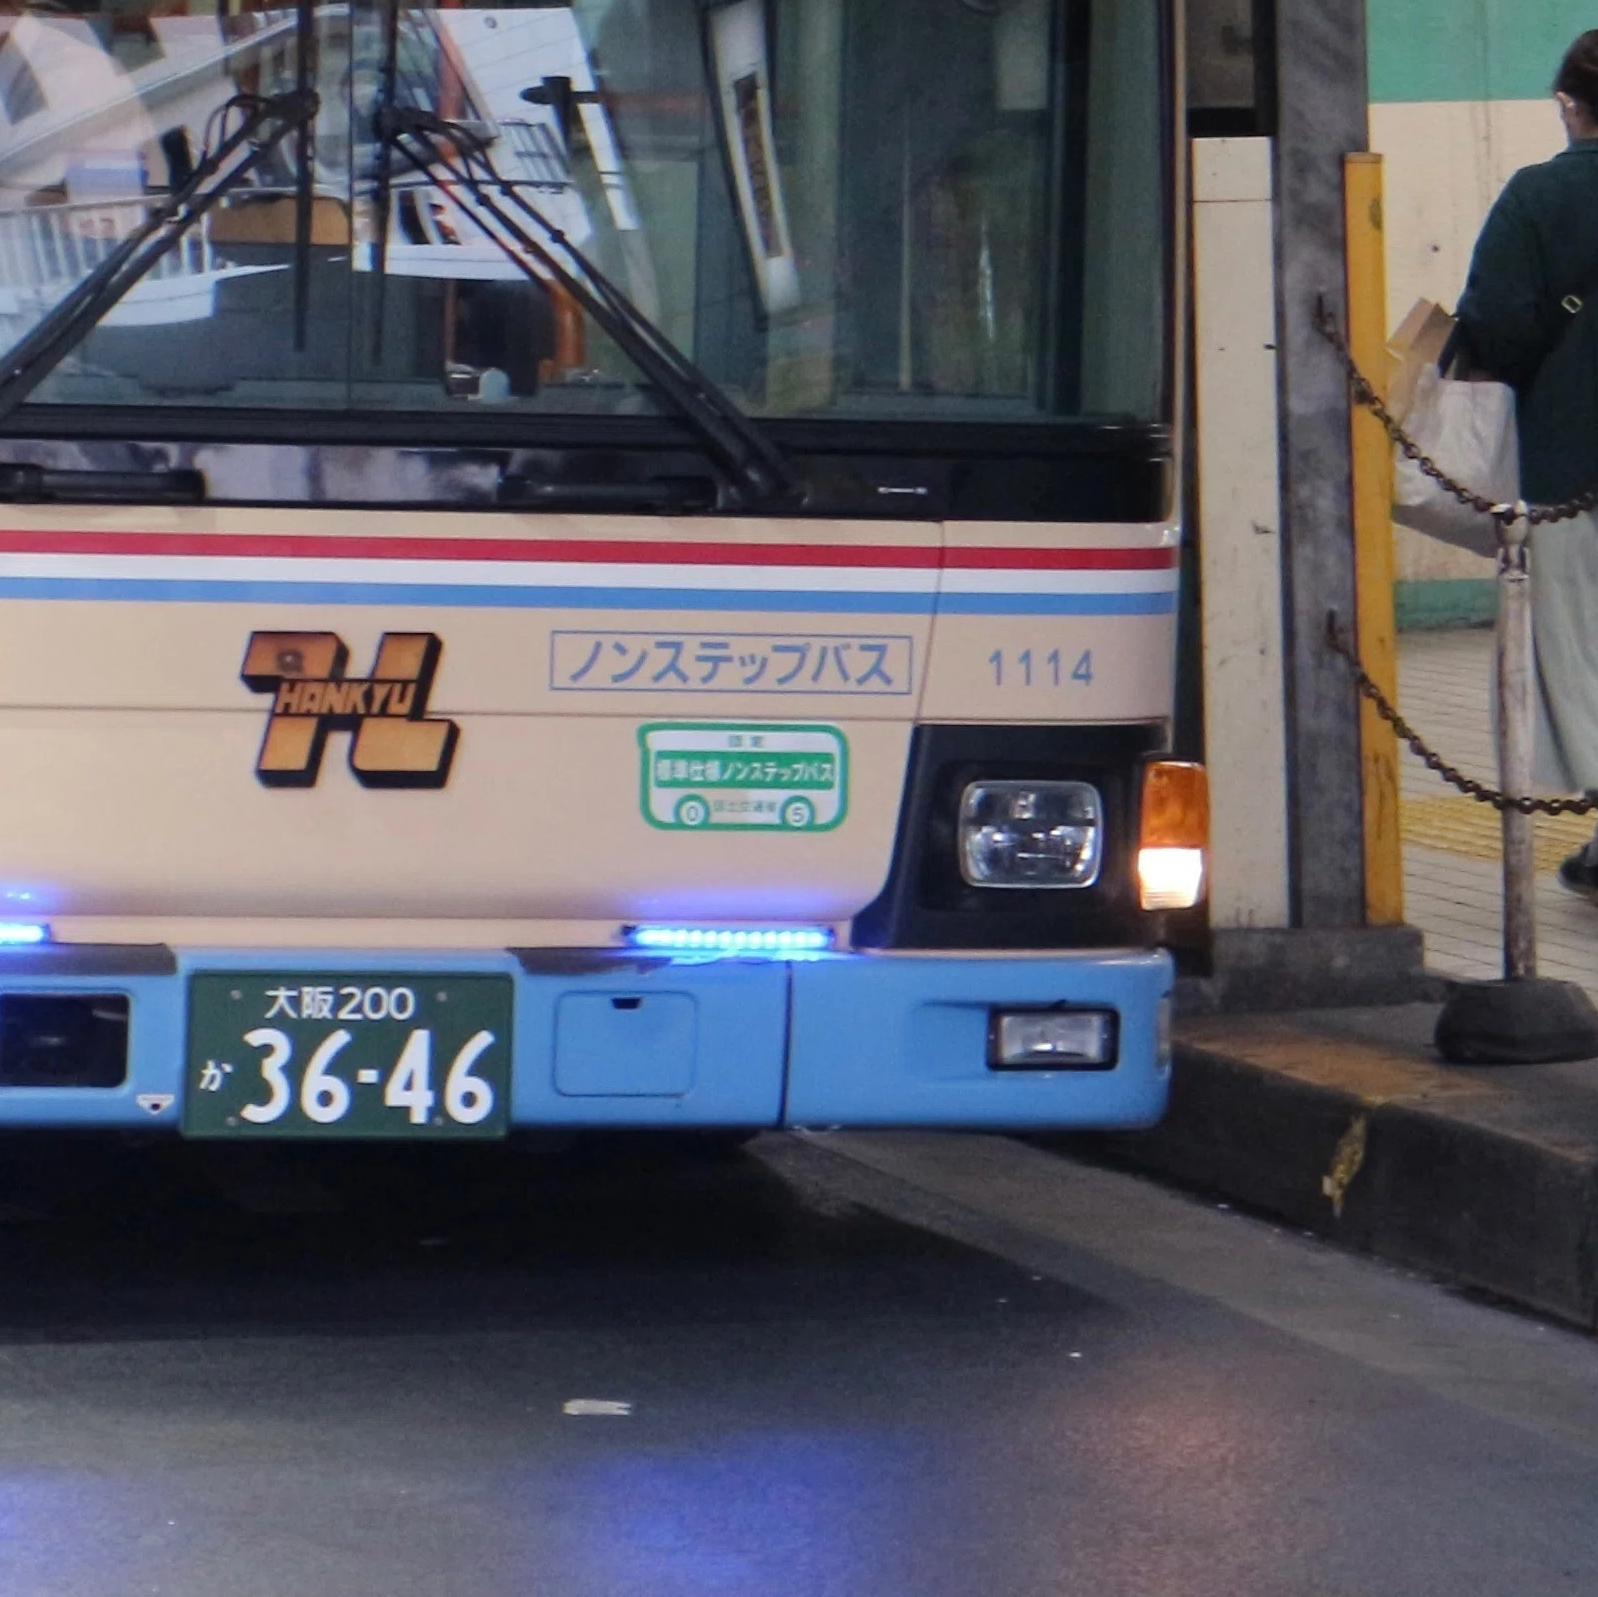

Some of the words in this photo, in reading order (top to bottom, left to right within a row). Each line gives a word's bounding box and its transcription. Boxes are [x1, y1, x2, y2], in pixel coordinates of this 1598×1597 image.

[568, 639, 894, 687] ノンステップバス
[988, 649, 1094, 687] 1114
[274, 681, 416, 714] HANKYU
[263, 985, 416, 1021] 大阪200
[198, 1059, 234, 1093] か
[239, 1027, 496, 1125] 36-46
